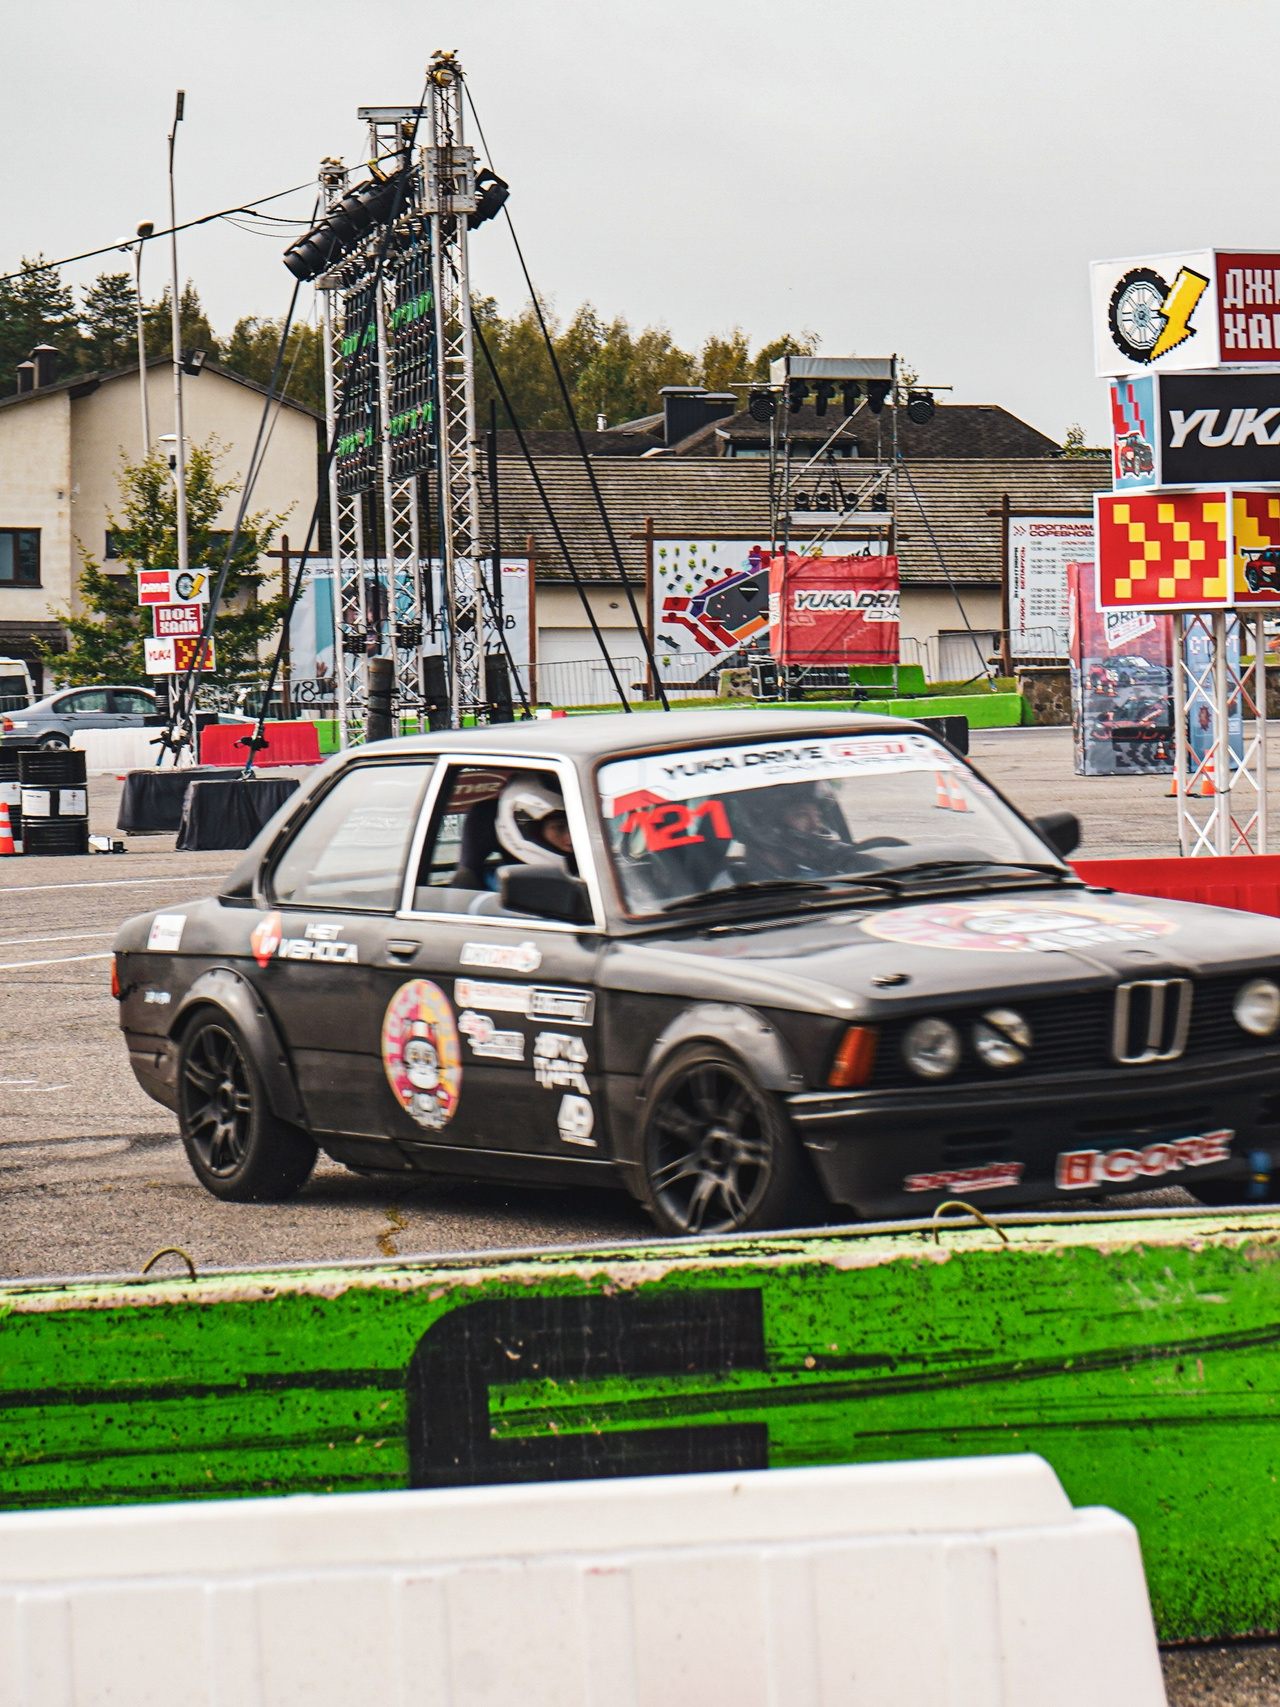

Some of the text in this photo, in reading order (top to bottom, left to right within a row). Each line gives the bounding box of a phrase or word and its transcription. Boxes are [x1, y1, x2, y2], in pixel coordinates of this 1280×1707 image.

[797, 593, 853, 609] YUKA
[158, 607, 197, 621] ПОЕ
[148, 649, 171, 661] YUKA
[663, 755, 737, 780] YUKA
[742, 745, 823, 767] DRIVE
[618, 800, 733, 851] 121
[305, 924, 344, 940] НЕТ
